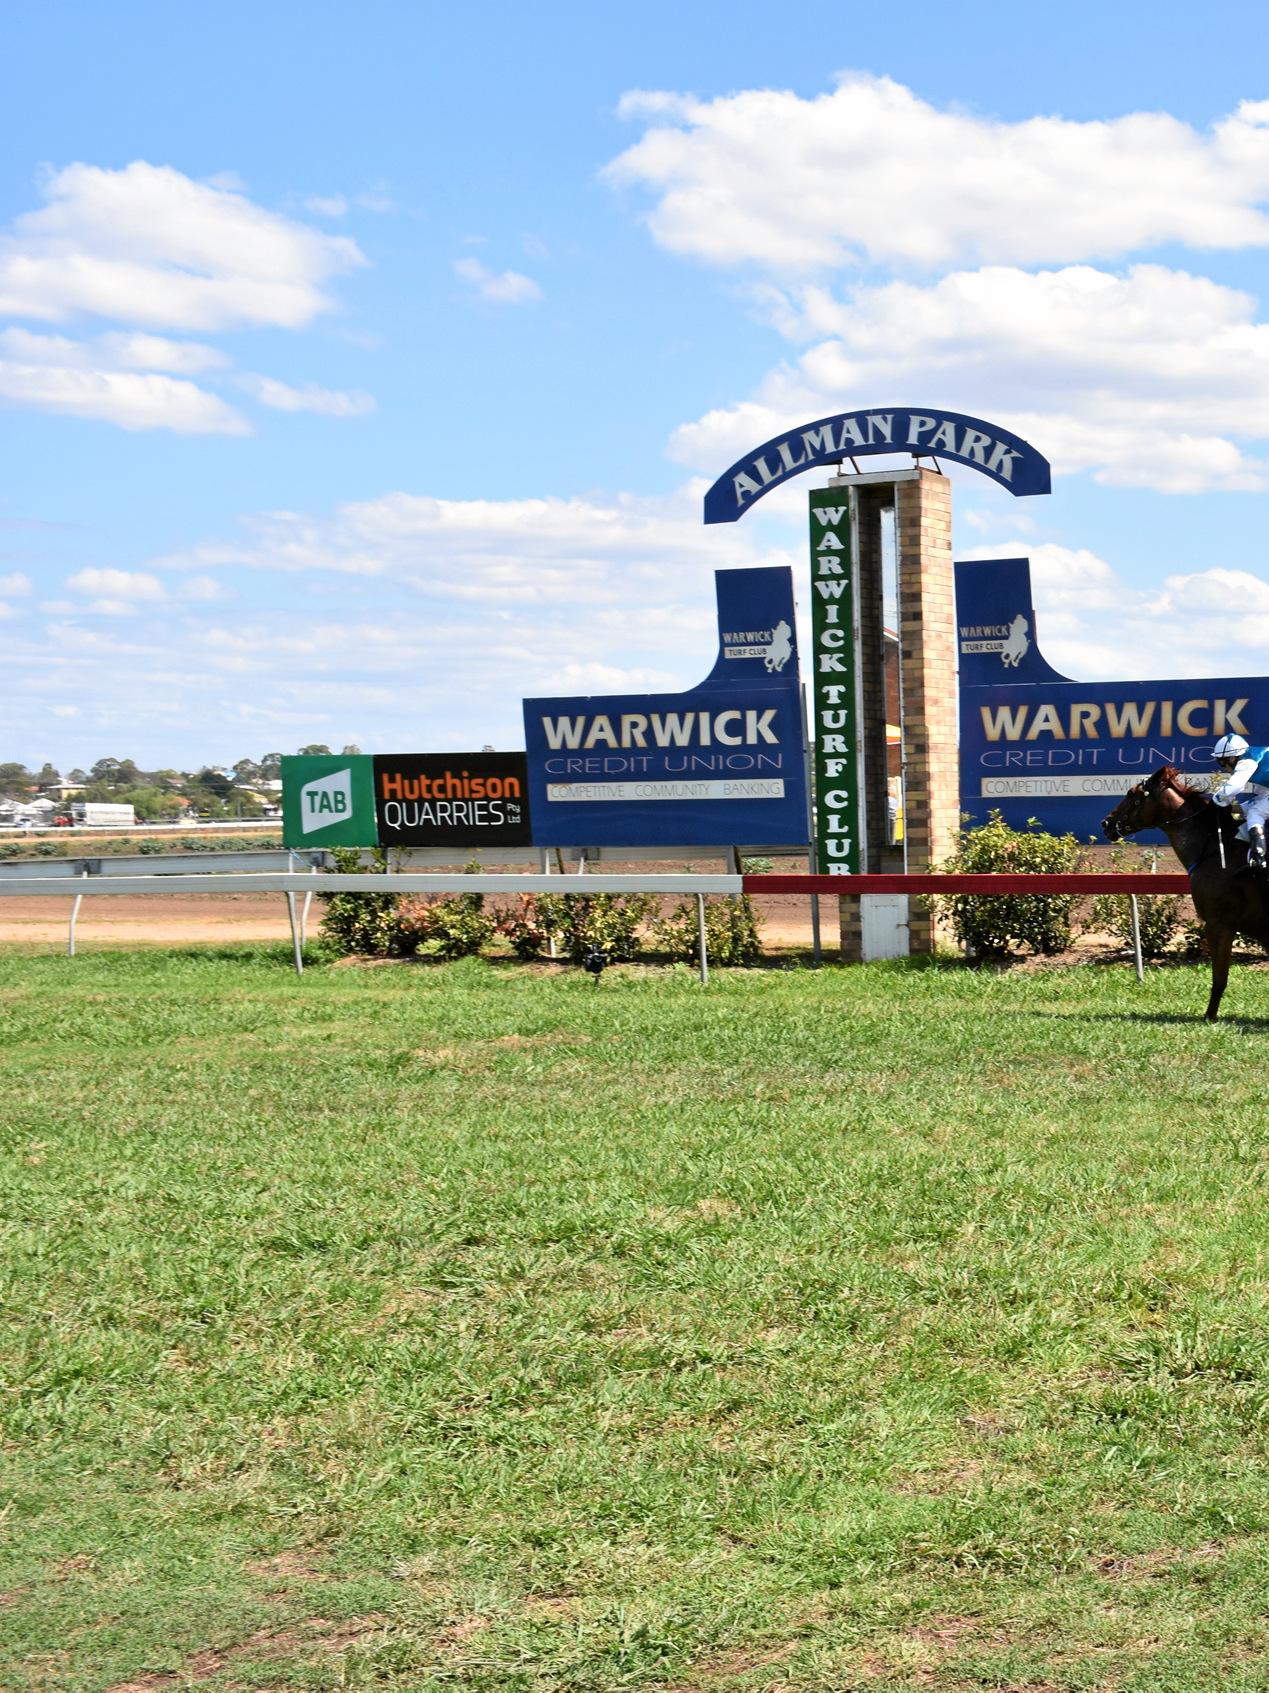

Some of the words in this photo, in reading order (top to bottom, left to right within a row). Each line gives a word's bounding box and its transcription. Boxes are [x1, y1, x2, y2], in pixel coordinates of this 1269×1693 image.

[732, 414, 894, 508] ALLMAN
[906, 414, 1025, 483] PARK
[812, 505, 849, 673] WARWICK
[722, 630, 772, 644] WARWICK
[960, 624, 1009, 638] WARWICK
[728, 649, 746, 657] TURF
[748, 648, 767, 656] CLUB
[965, 643, 984, 651] TURF
[985, 642, 1004, 650] CLUB
[541, 709, 780, 750] WARWICK
[820, 684, 849, 778] TURF
[980, 698, 1250, 742] WARWICK
[544, 757, 653, 774] CREDIT
[665, 753, 783, 771] UNION
[979, 748, 1106, 767] CREDIT
[1118, 746, 1217, 765] UNIO
[382, 771, 521, 800] Hutchison
[551, 785, 625, 799] COMPETITIVE
[635, 783, 710, 798] COMMUNITY
[724, 782, 780, 796] BANKING
[985, 779, 1071, 794] COMPETITIVE
[306, 790, 347, 814] TAB
[384, 801, 504, 830] QUARRIES
[823, 789, 852, 875] CLUB
